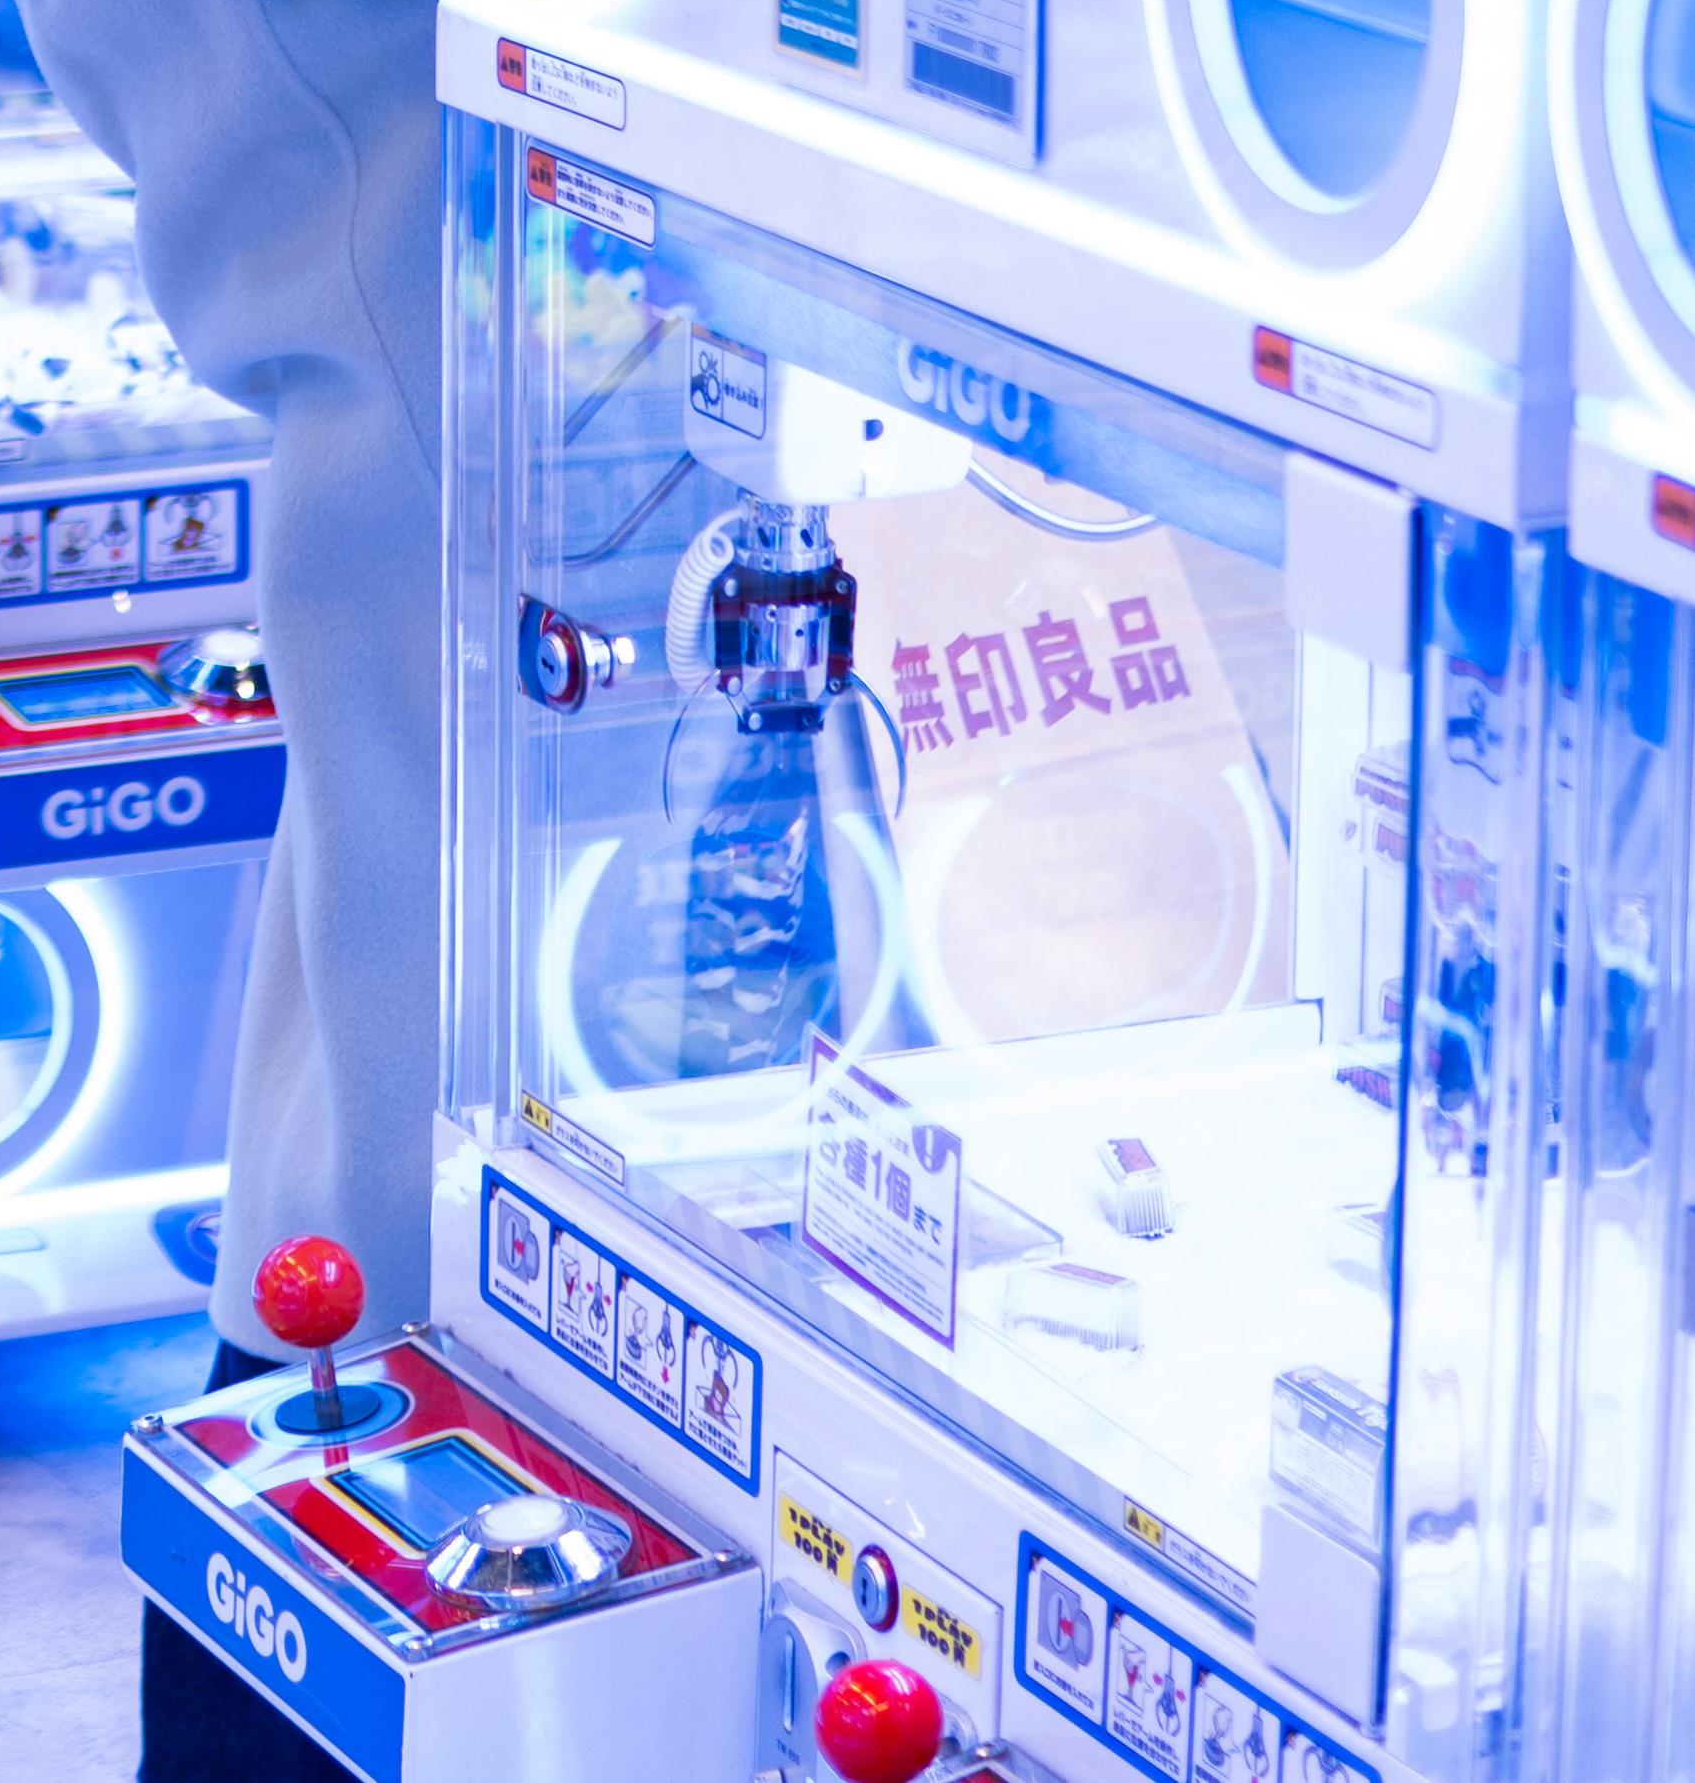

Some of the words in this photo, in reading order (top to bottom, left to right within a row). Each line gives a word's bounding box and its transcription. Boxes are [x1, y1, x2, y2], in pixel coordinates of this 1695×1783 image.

[892, 596, 1191, 752] 無印良品
[42, 776, 206, 839] GiGO
[207, 1552, 307, 1683] GiGO
